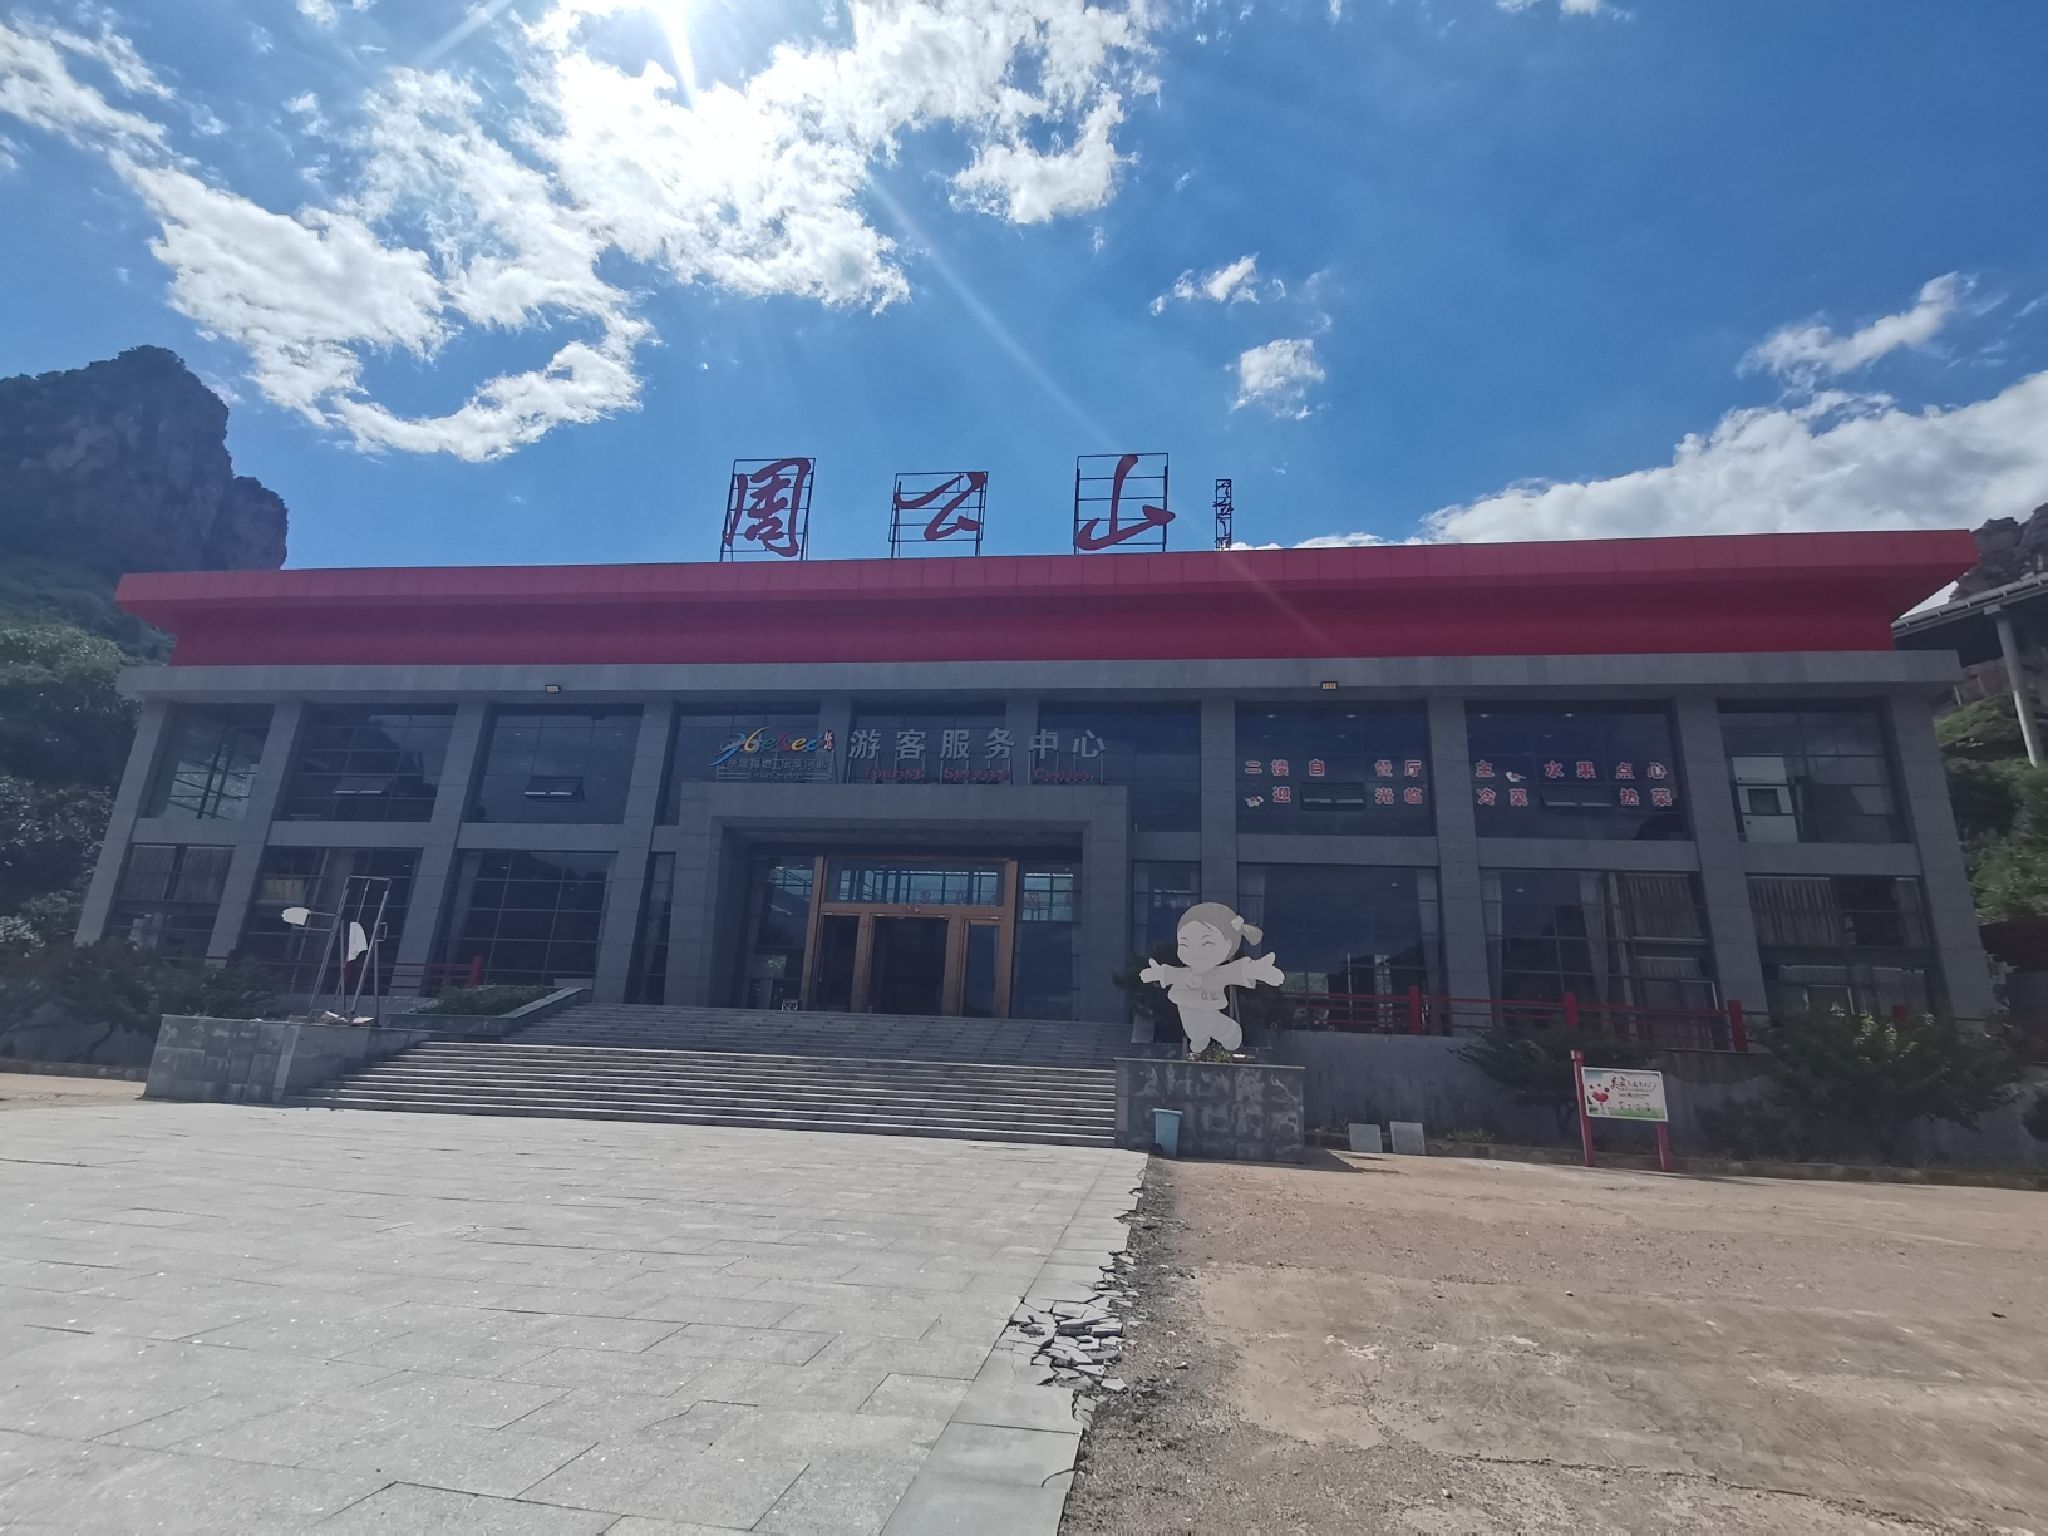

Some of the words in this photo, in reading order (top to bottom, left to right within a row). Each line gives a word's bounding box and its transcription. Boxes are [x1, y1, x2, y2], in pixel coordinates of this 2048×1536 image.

[847, 727, 1107, 761] 游客服务中心
